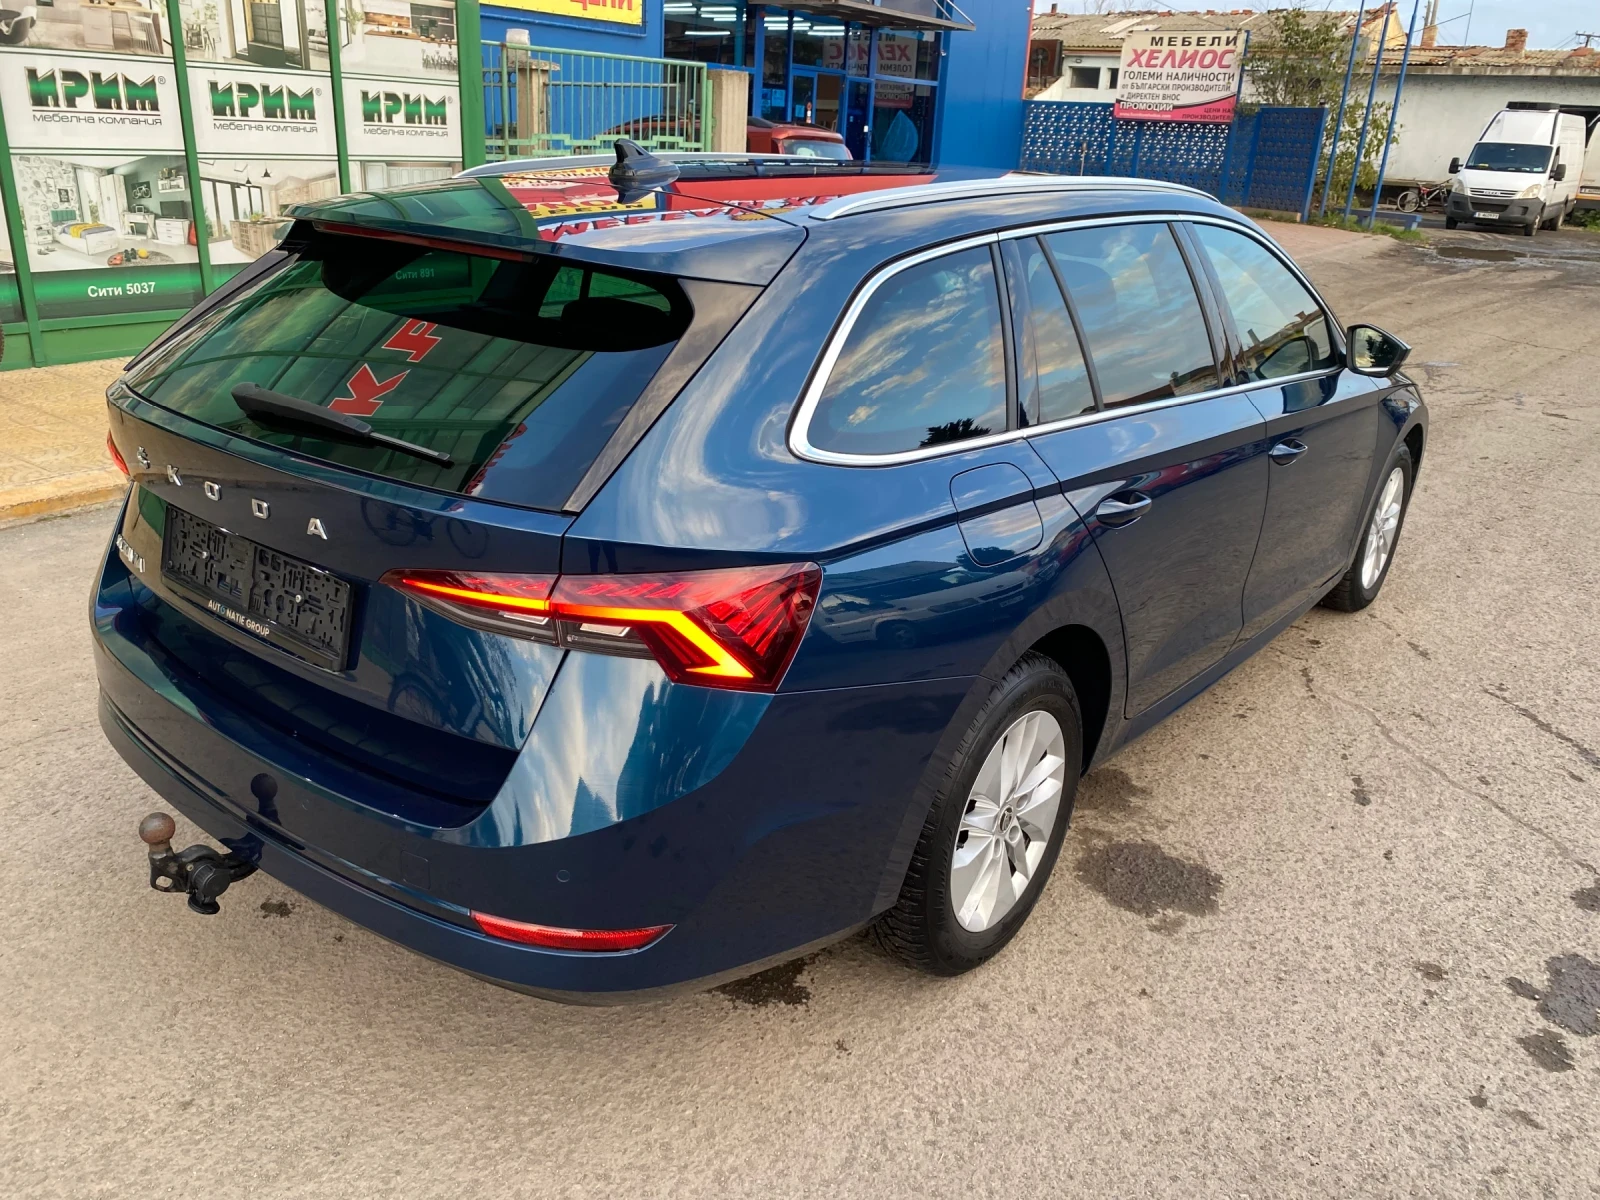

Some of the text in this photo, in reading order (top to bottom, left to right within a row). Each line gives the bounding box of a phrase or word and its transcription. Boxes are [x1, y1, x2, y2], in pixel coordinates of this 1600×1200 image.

[1150, 36, 1238, 47] МЕБЕЛИ
[1127, 49, 1236, 68] ХЕЛИОС
[1123, 71, 1235, 82] ГОЛЕМИ НАЛИЧНОСТИ
[1130, 83, 1170, 91] БЪЛГАРСКИ
[1172, 83, 1231, 92] ПРОИЗВОДИТЕЛИ
[1126, 92, 1160, 101] ДИРЕКТЕН
[1162, 93, 1180, 101] ВНОС
[1120, 101, 1173, 113] ПРОМОЦИИ
[32, 114, 162, 126] мебелна компания
[213, 122, 318, 133] мебелна компания
[395, 268, 435, 280] Сити 891
[87, 282, 156, 297] Сити 5037
[245, 619, 270, 637] GROUP
